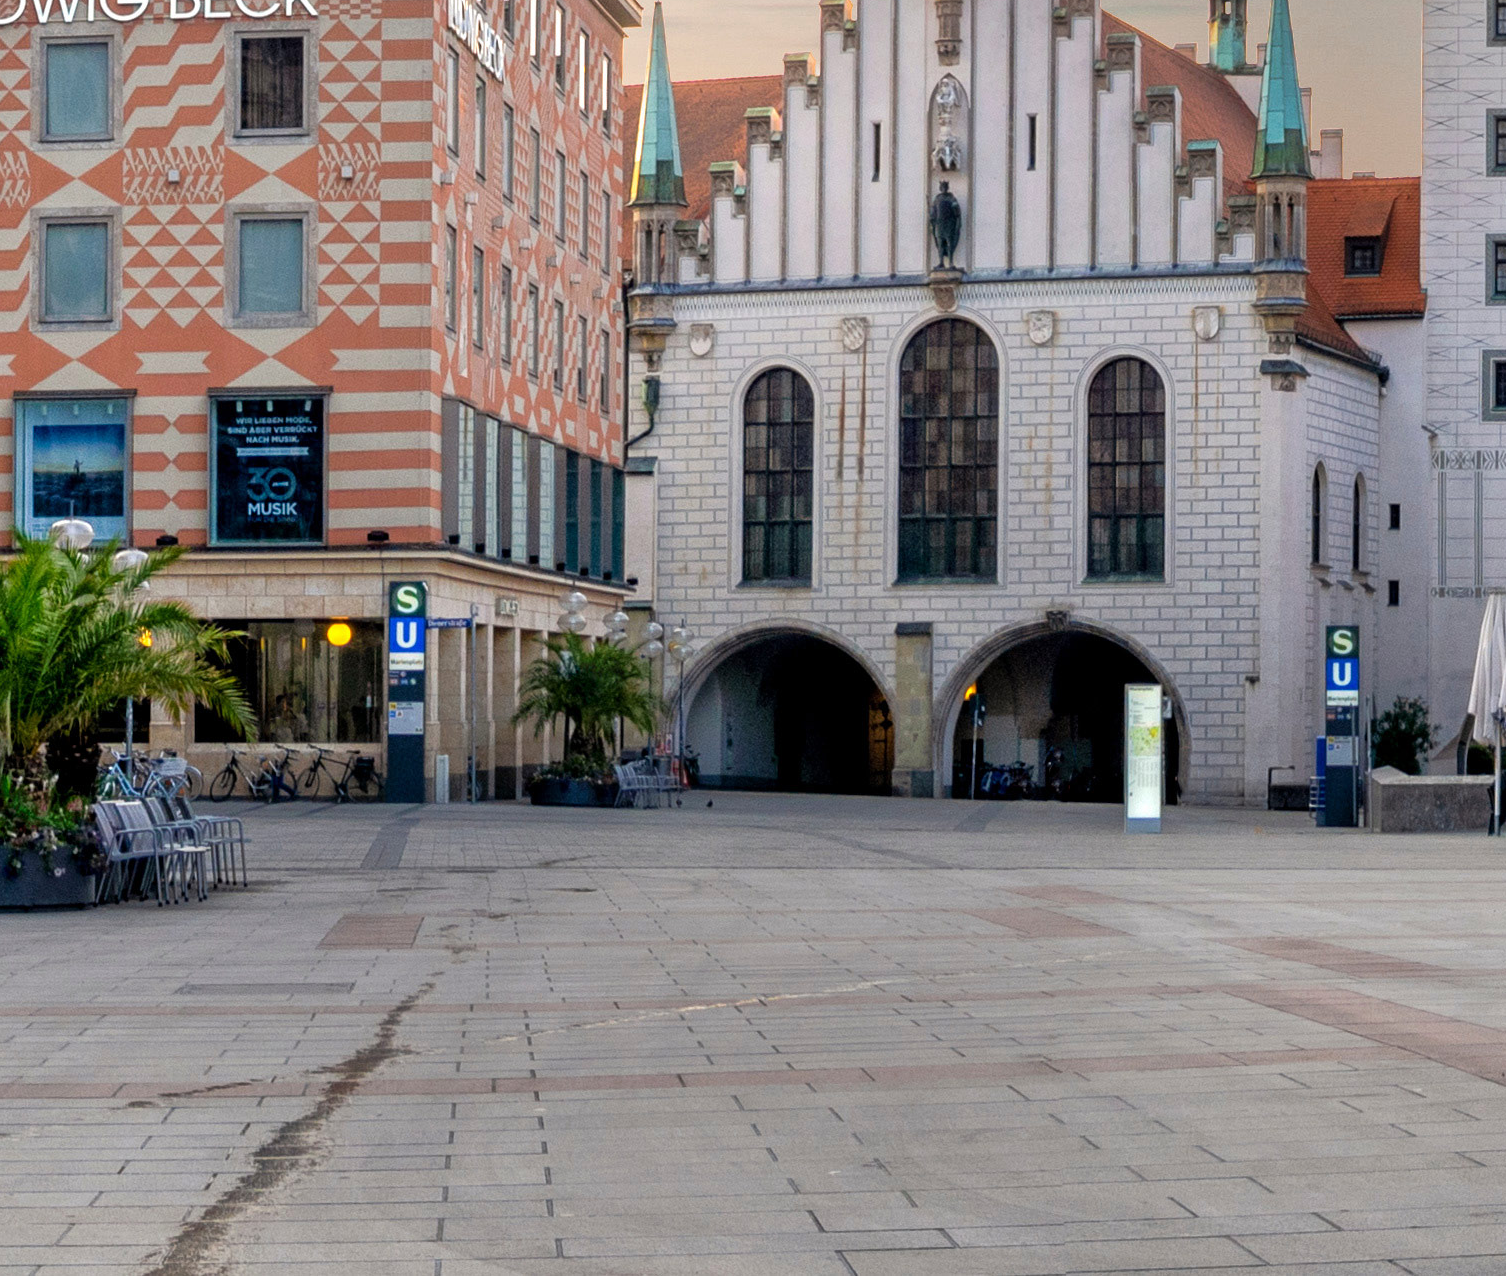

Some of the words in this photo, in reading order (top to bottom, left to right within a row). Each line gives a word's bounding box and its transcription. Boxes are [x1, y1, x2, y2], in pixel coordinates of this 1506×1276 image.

[247, 467, 297, 501] 30
[247, 502, 298, 515] MUSIK
[397, 586, 419, 613] S
[396, 621, 417, 648] U
[1333, 630, 1353, 655] S
[1332, 662, 1352, 686] U
